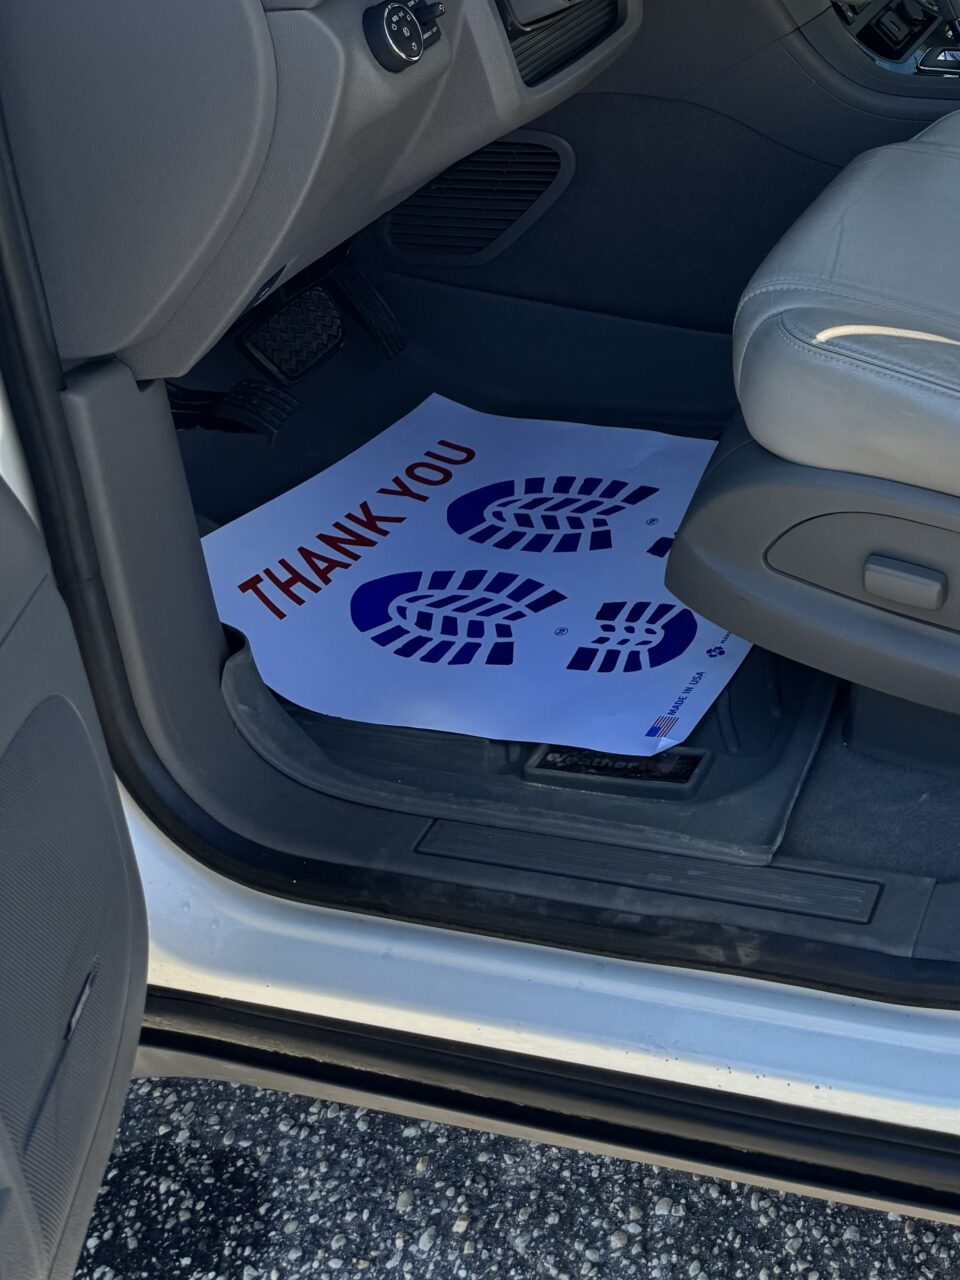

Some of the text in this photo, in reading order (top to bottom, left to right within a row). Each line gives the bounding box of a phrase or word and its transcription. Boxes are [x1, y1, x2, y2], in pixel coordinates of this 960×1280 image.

[238, 439, 476, 620] THANK YOU
[667, 671, 706, 716] MADE IN USA
